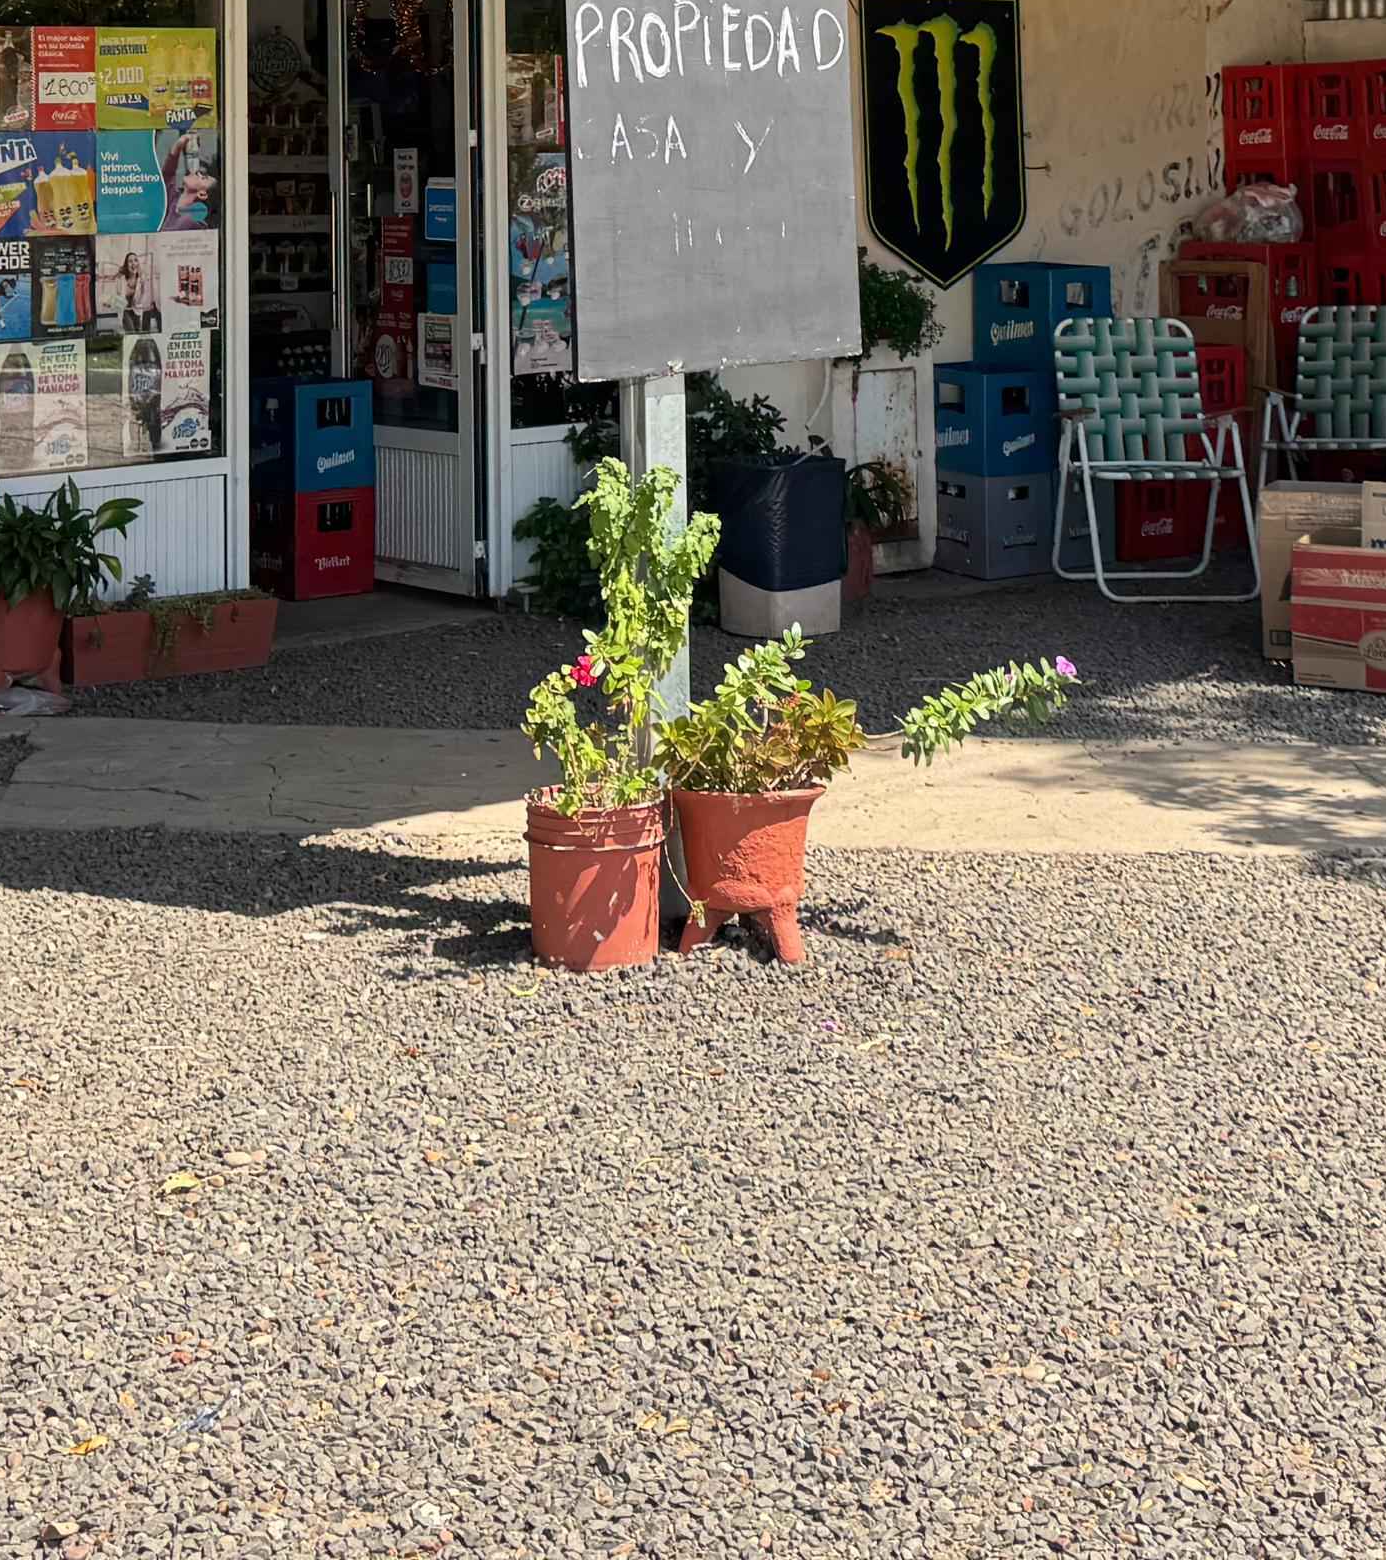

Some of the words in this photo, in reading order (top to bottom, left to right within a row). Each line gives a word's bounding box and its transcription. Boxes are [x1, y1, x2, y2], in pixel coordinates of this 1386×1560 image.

[165, 108, 197, 123] FANTA
[1239, 128, 1273, 145] Coca-Cola
[1313, 124, 1349, 140] Coca-Cola
[100, 173, 160, 184] Benedictino
[990, 319, 1035, 346] Quilmes
[178, 360, 205, 368] TOMA
[936, 425, 970, 448] uilmes
[317, 449, 355, 474] Quilmes
[1141, 517, 1174, 537] Coca-Cola
